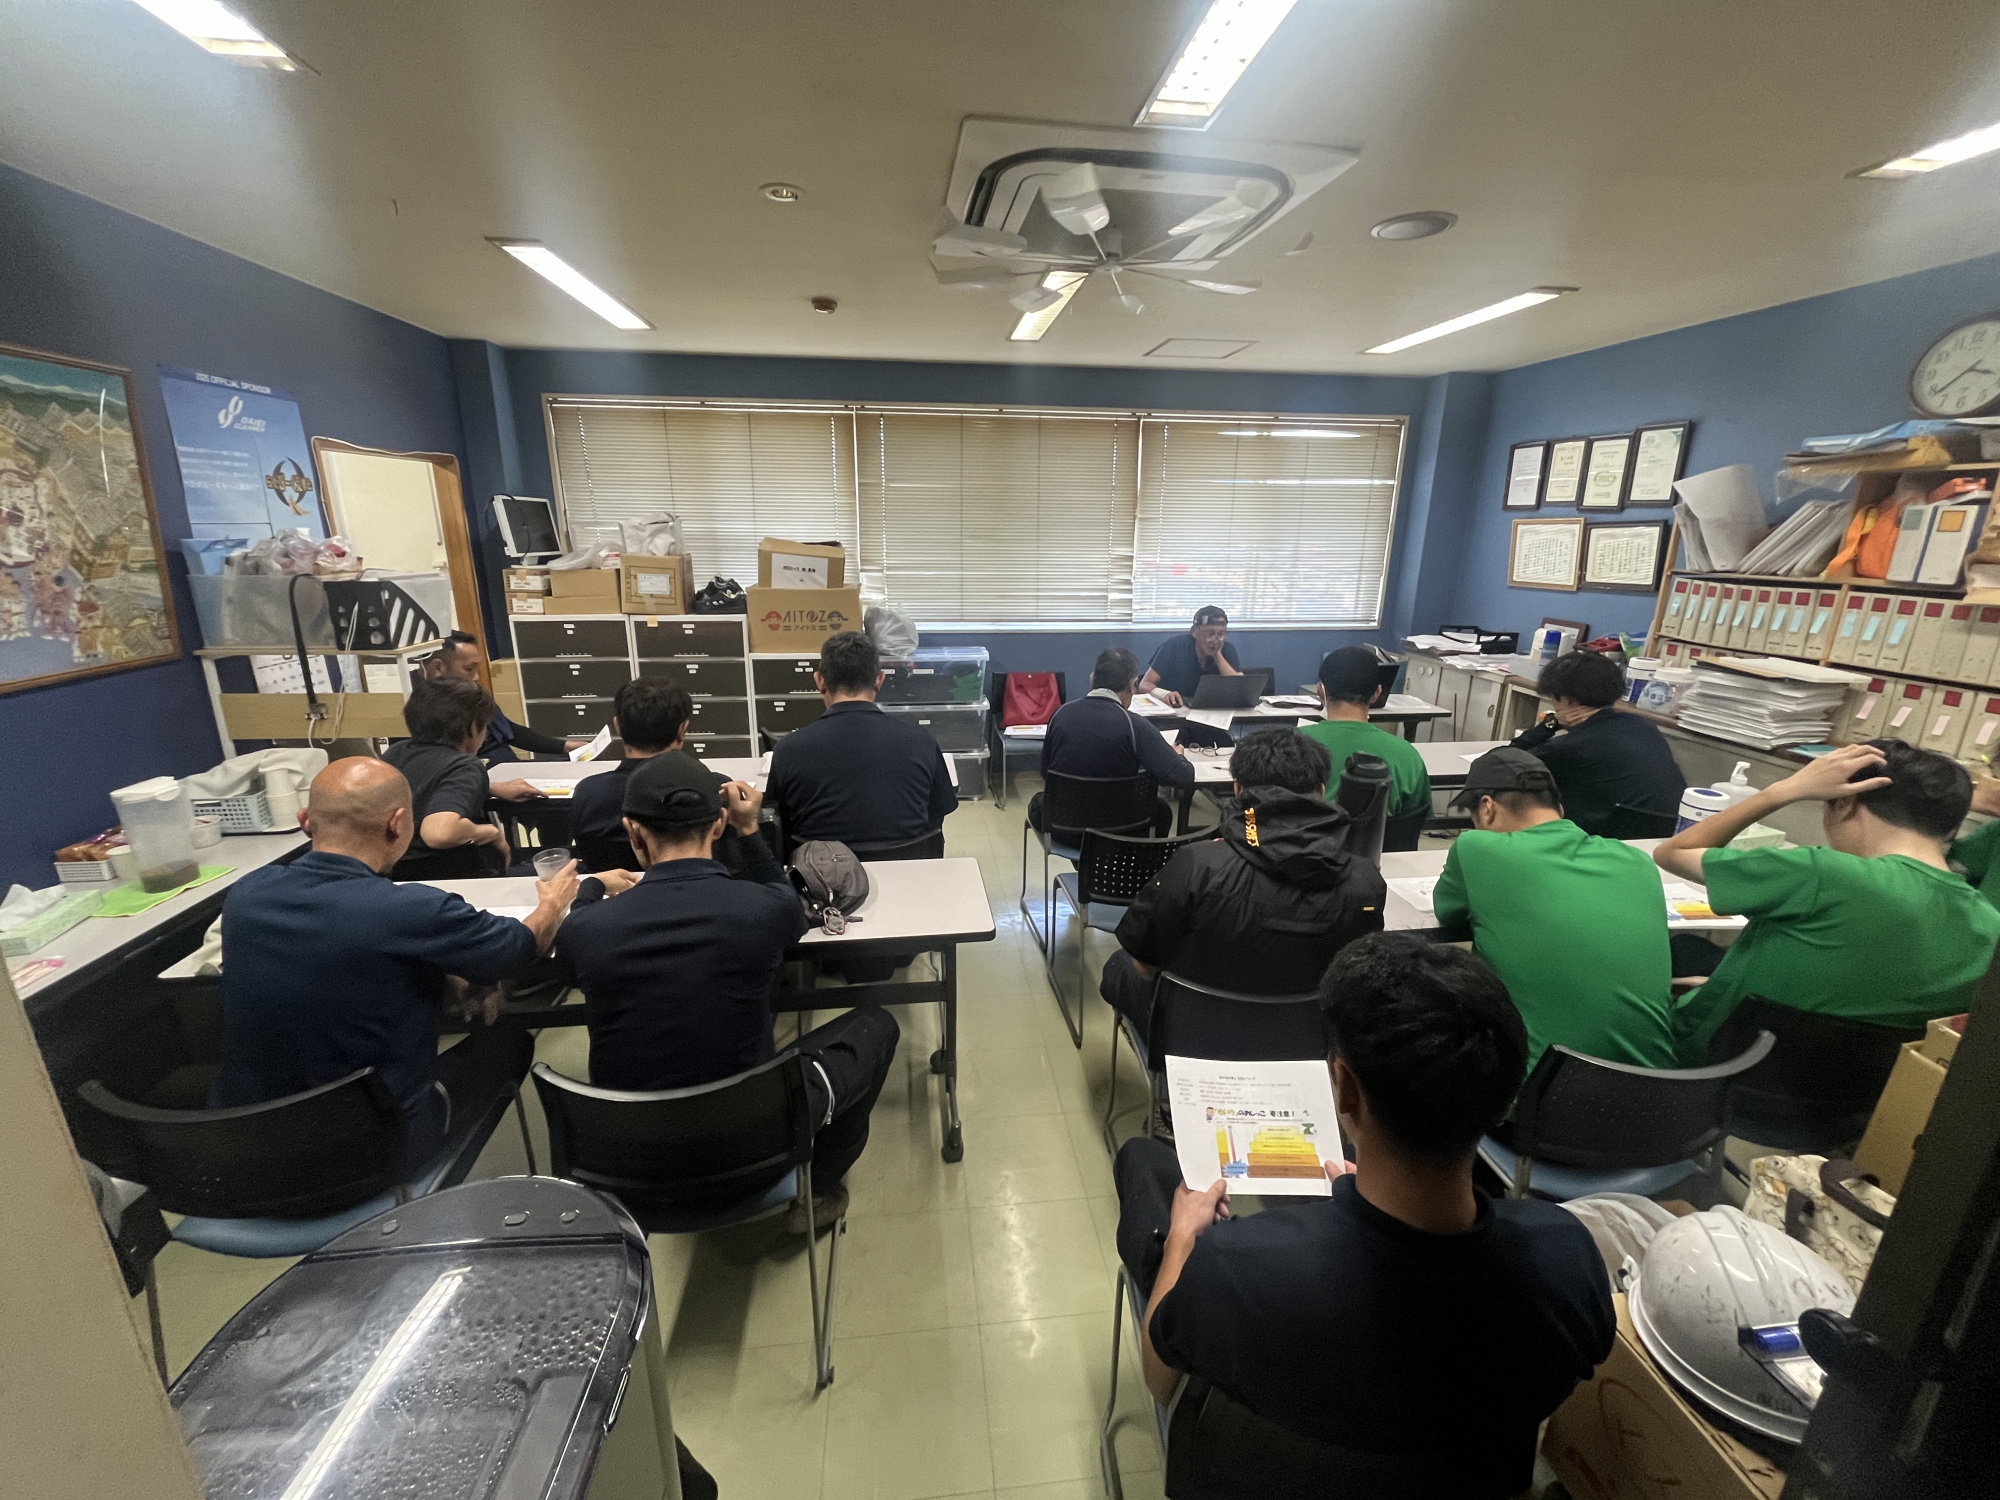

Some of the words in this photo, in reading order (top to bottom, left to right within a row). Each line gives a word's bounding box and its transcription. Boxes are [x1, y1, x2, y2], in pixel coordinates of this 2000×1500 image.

[211, 376, 240, 388] OFFICIAL
[241, 382, 271, 394] SPONSOR
[782, 610, 827, 623] AITOZ
[793, 624, 817, 632] アイトス
